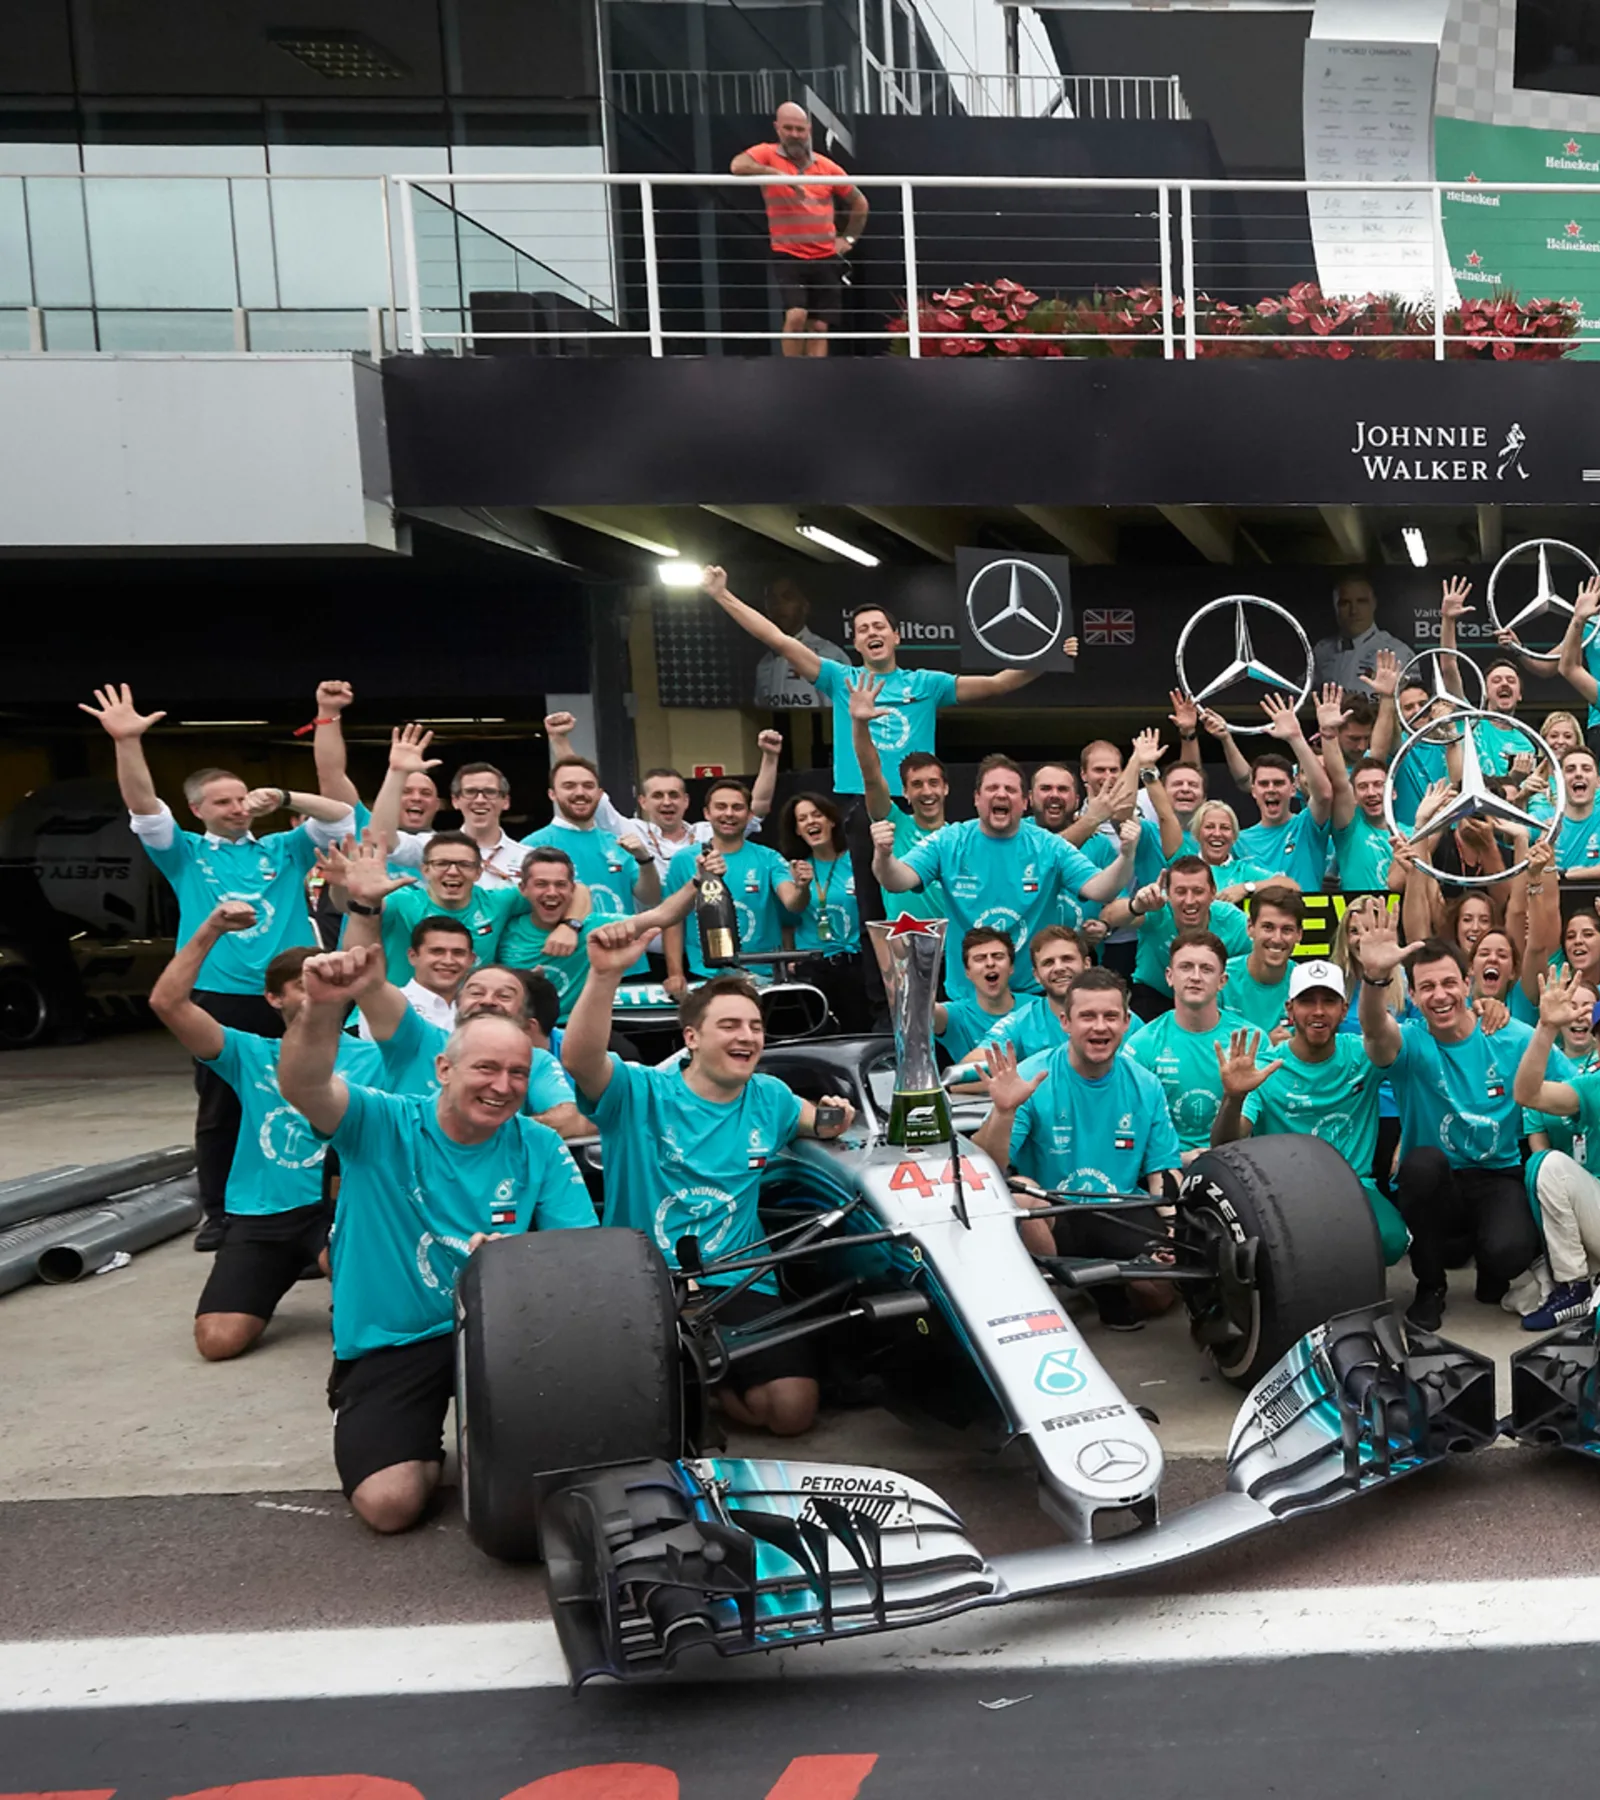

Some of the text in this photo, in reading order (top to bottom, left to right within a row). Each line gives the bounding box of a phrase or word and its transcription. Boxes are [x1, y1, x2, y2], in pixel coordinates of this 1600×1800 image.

[1545, 156, 1600, 172] Heineken
[1446, 191, 1500, 206] Heineken
[1546, 238, 1600, 252] Heineken
[1351, 421, 1488, 453] JOHNNIE
[1362, 456, 1489, 481] WALKER
[844, 621, 955, 639] Hilton
[1415, 621, 1495, 638] Botas
[49, 865, 130, 880] SAFETY
[890, 1154, 991, 1198] 44
[1206, 1181, 1247, 1244] ZER
[1254, 1369, 1292, 1407] PETRONAS
[1041, 1404, 1127, 1433] PIRELLI
[800, 1476, 896, 1494] PETRONAS
